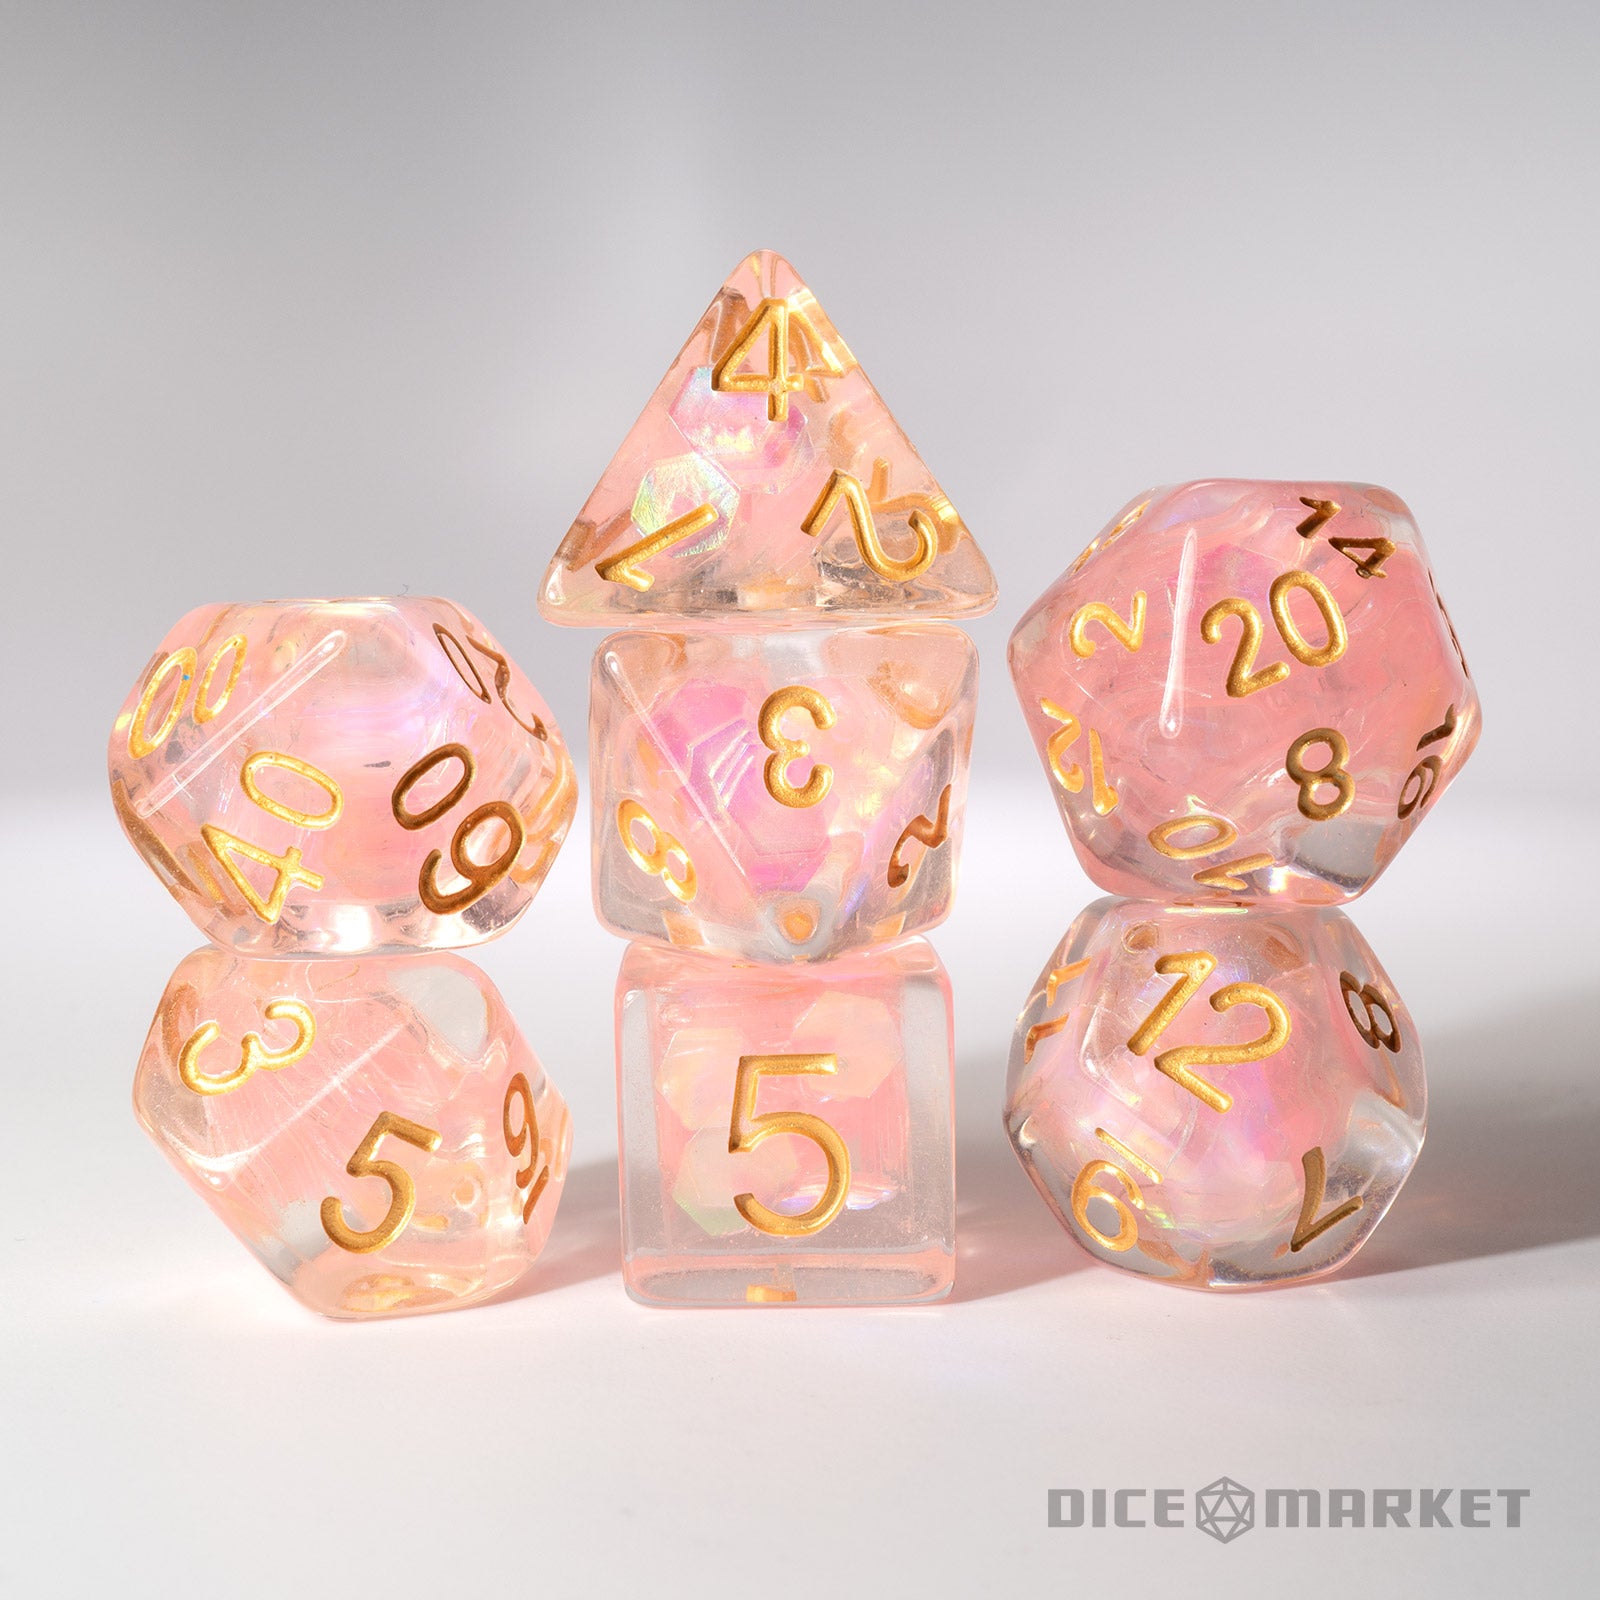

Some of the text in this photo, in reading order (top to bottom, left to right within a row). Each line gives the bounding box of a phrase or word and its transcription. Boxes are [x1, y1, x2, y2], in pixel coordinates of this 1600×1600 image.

[711, 297, 804, 422] 4
[800, 468, 938, 582] 2
[1296, 496, 1397, 579] 14
[1069, 590, 1147, 659] 2
[1200, 570, 1348, 698] 20
[758, 685, 837, 809] 3
[1285, 727, 1355, 821] 8
[201, 751, 344, 924] 40
[616, 798, 697, 903] 8
[887, 784, 952, 888] 2
[179, 998, 317, 1097] 3
[1126, 950, 1292, 1114] 12
[1339, 970, 1401, 1054] 8
[320, 1111, 443, 1254] 5
[728, 1053, 851, 1237] 5
[1290, 1146, 1364, 1253] 7
